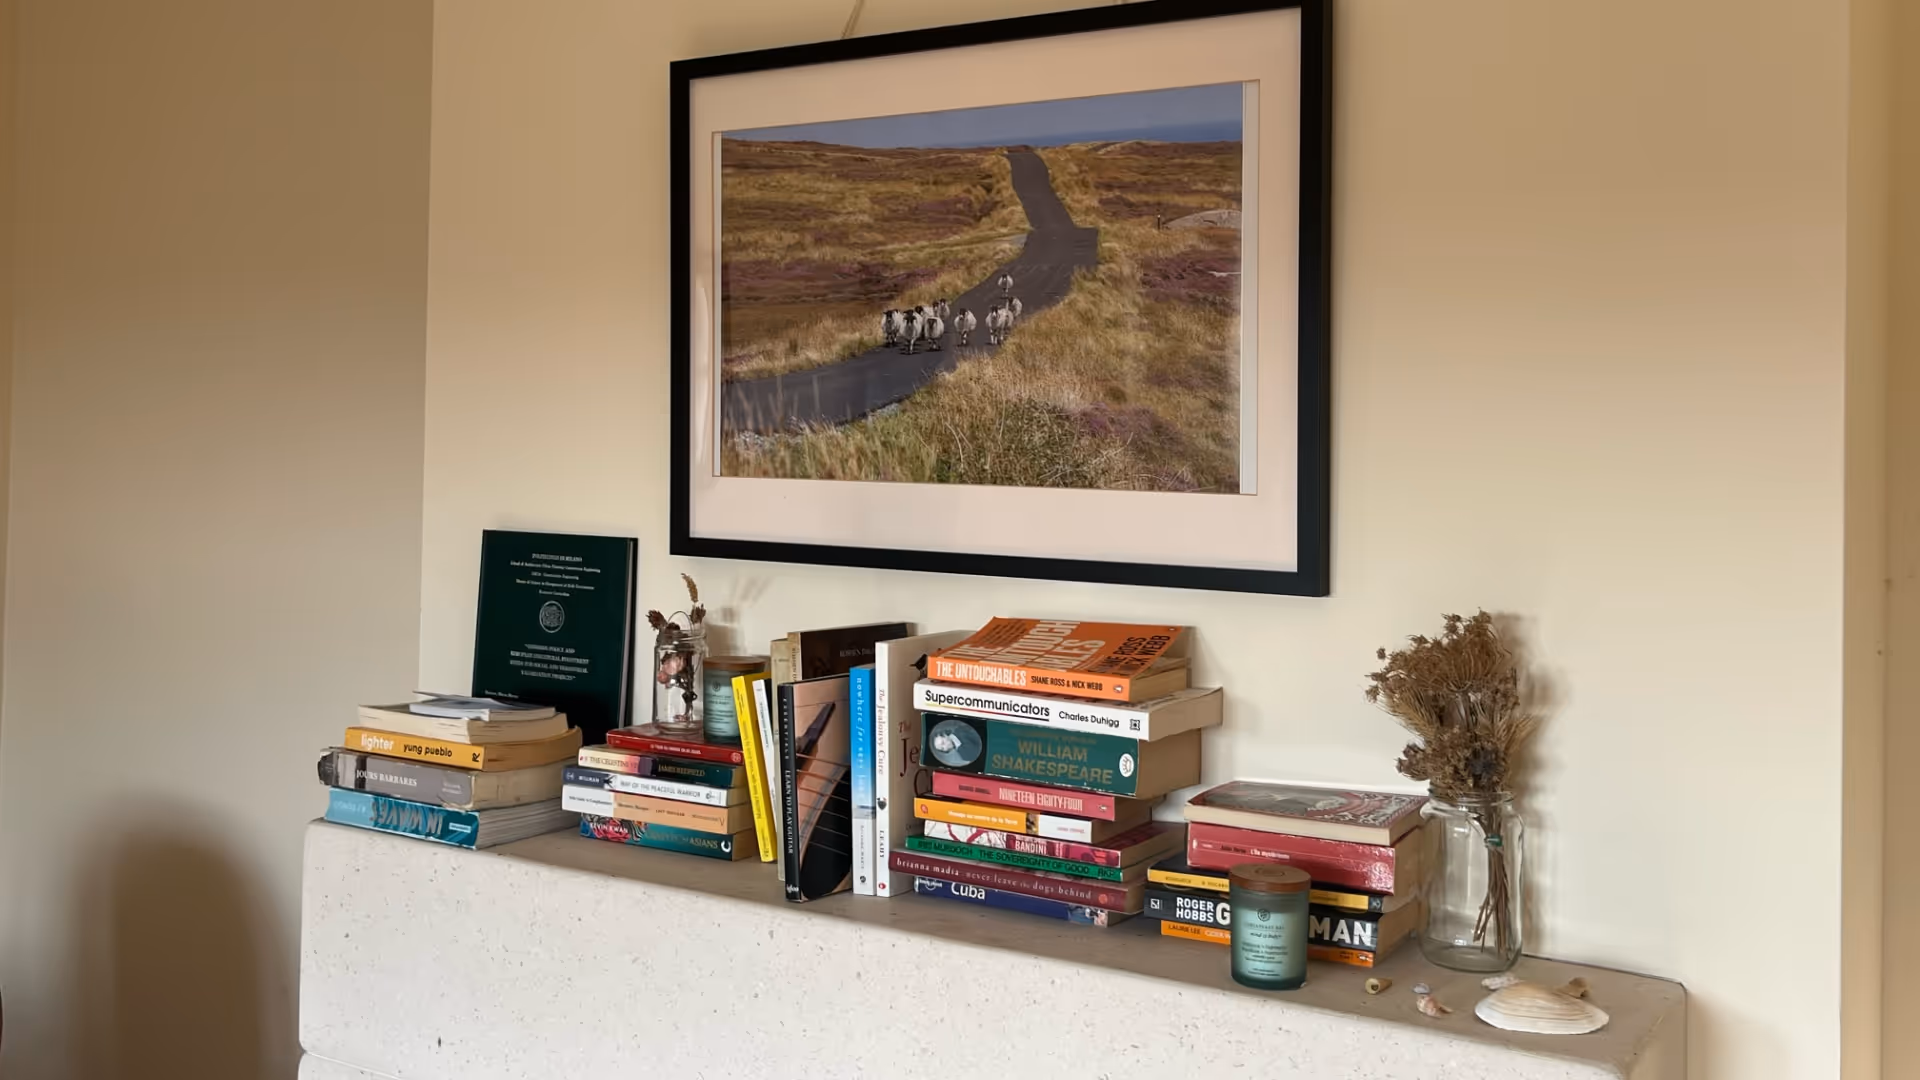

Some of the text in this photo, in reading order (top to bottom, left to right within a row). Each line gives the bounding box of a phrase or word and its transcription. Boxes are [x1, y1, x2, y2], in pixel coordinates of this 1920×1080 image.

[1112, 636, 1147, 656] ROSS
[1135, 635, 1171, 655] WEBB
[935, 660, 1027, 686] THE UNTOUCHABLES
[1031, 675, 1050, 685] SHANE
[1050, 678, 1065, 687] ROSS
[1072, 679, 1086, 690] NICK
[1087, 681, 1103, 691] WEBB
[925, 689, 1120, 728] Supercommunicators Charles Duhigg
[361, 733, 394, 751] lighter
[403, 744, 422, 754] yung
[424, 747, 452, 757] pueblo
[1017, 739, 1088, 762] WILLIAM
[356, 769, 418, 787] JOURS BARBARES
[992, 754, 1113, 785] SHAKESPEARE
[651, 784, 676, 794] PEACEFUL
[677, 788, 701, 798] WARRIOR
[786, 795, 792, 805] TO
[999, 787, 1036, 806] NINETEEN
[590, 821, 608, 832] KEVIN
[608, 824, 628, 834] KWAN
[689, 837, 718, 849] ASIANS
[1015, 839, 1047, 855] BANDINI
[934, 842, 973, 856] MURDOCH
[979, 849, 995, 860] THE
[996, 851, 1050, 868] SOVEREIGNTY
[1052, 860, 1063, 870] OF
[1064, 863, 1089, 875] GOOD
[896, 858, 931, 873] brianna
[932, 863, 960, 877] madia
[965, 871, 990, 882] never
[993, 873, 1017, 887] leave
[1032, 879, 1055, 895] dogs
[1058, 884, 1092, 900] behind
[950, 881, 986, 900] Cuba
[1176, 896, 1214, 912] ROGER
[1175, 908, 1214, 924] HOBBS
[1190, 926, 1201, 935] LEE
